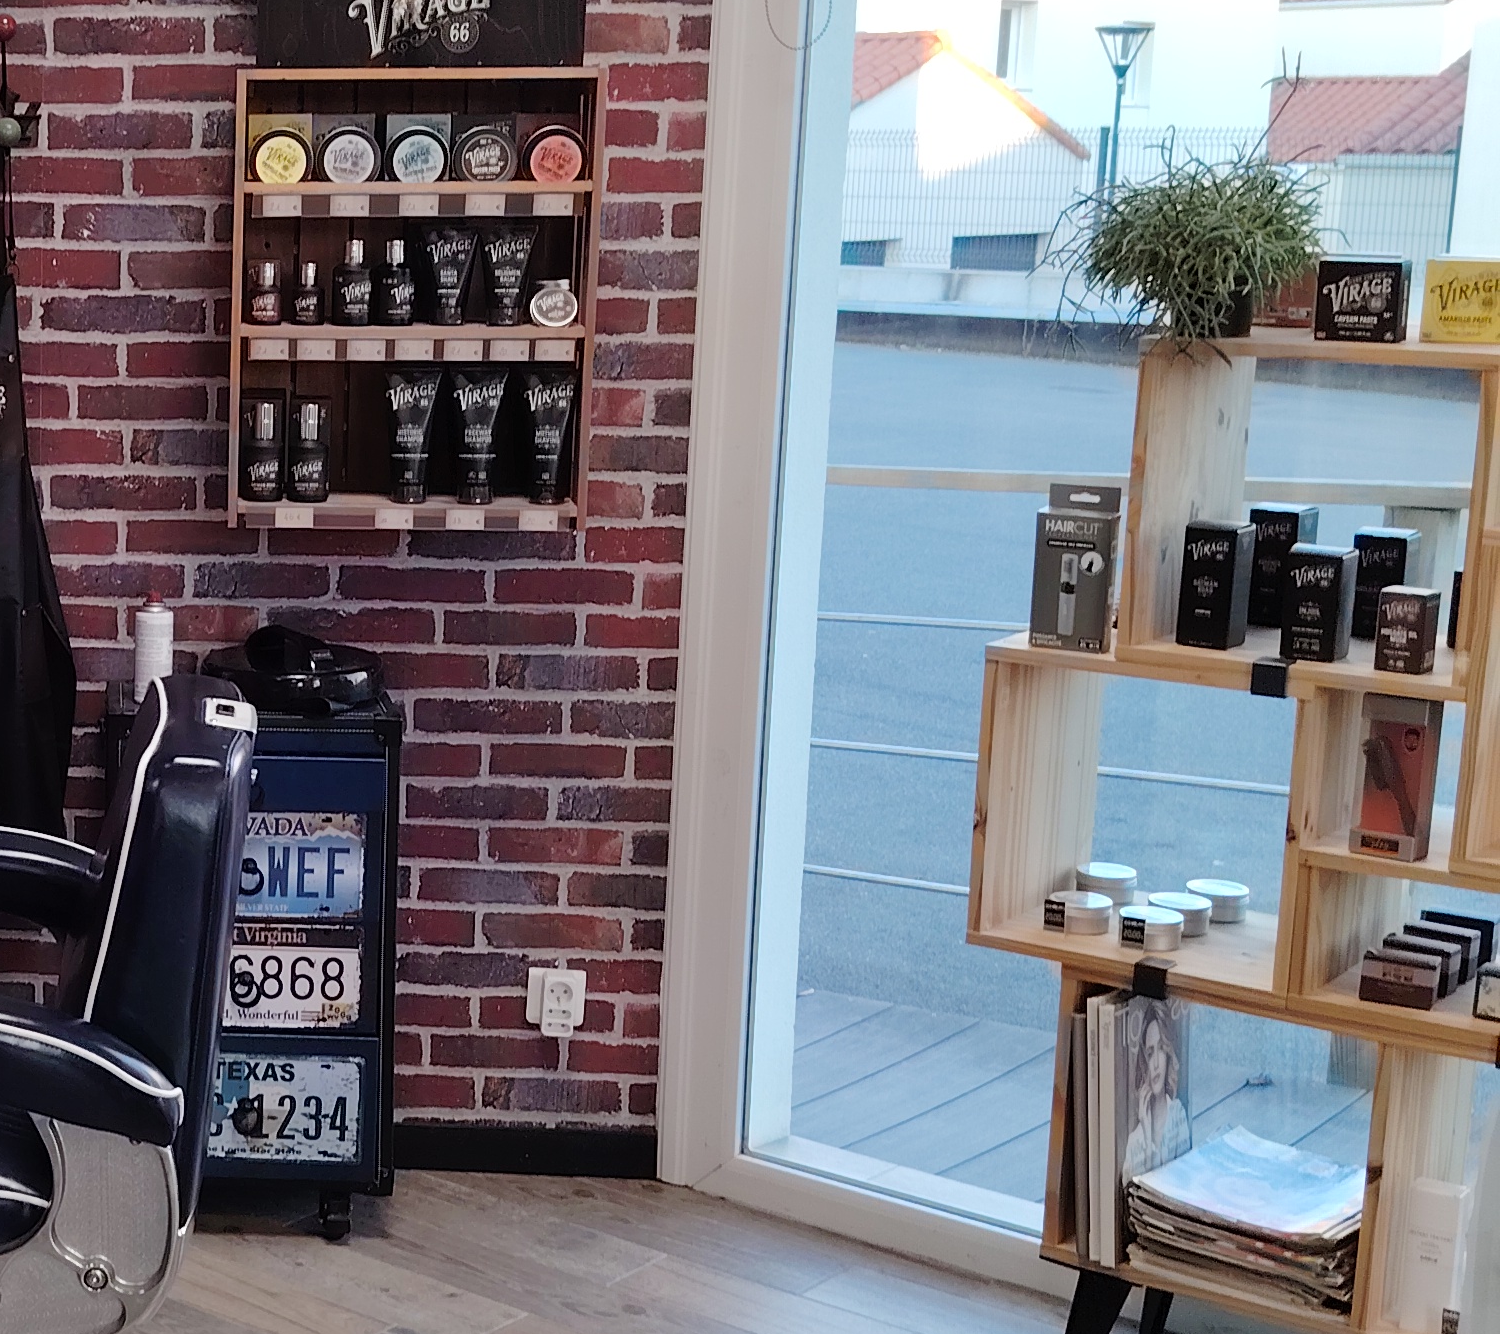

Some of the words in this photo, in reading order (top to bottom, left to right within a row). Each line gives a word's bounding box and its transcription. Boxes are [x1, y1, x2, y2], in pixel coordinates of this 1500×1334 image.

[450, 22, 470, 43] 66
[466, 146, 500, 173] VIRAGE
[427, 239, 471, 264] VIRAGE
[485, 239, 531, 264] VIRAGE
[1322, 275, 1392, 314] VIRAGE
[385, 383, 436, 411] VIRAGE
[453, 383, 504, 412] VIRAGE
[524, 384, 574, 412] VIRAGE
[247, 462, 279, 481] VIRAGE
[291, 461, 323, 481] VIRAGE
[1045, 519, 1100, 535] HAIRCUT
[1187, 539, 1229, 561] VIRAGE
[1361, 548, 1399, 567] VIRAGE
[1290, 565, 1335, 587] VIRAGE
[246, 816, 309, 836] VADA
[243, 927, 307, 945] Virginia
[238, 1009, 299, 1024] Wonderful
[216, 1061, 295, 1082] TEXAS
